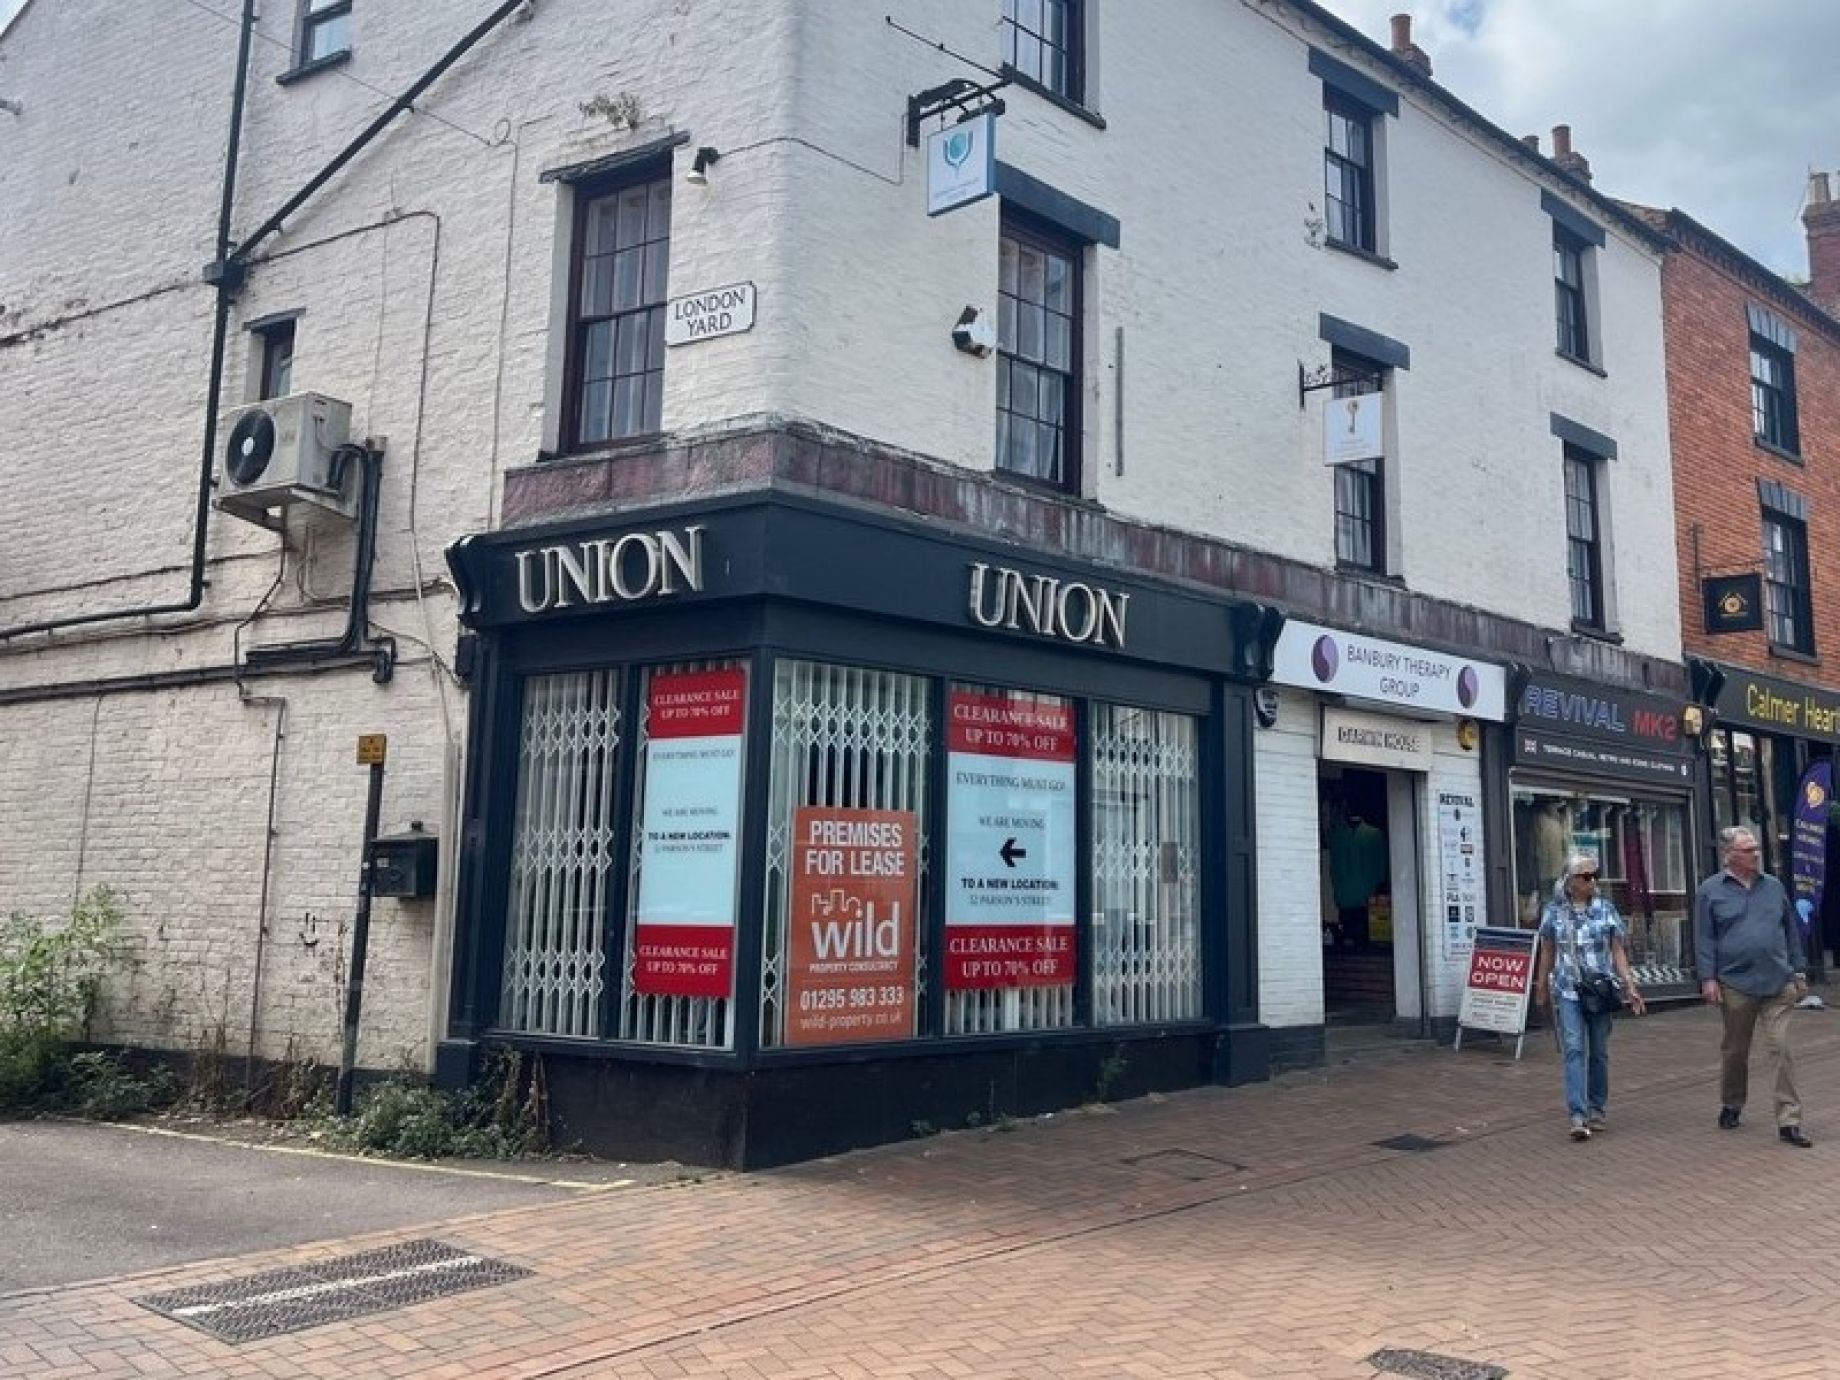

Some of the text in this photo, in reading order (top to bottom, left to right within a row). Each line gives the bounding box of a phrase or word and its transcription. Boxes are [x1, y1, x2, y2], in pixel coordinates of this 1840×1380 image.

[674, 286, 746, 321] LONDON
[688, 312, 732, 336] YARD
[515, 524, 707, 613] UNION
[969, 562, 1131, 648] UNION
[1347, 643, 1451, 681] BANBURY THERAPY
[655, 689, 738, 705] CLEARANCE SALE
[1380, 676, 1420, 697] GROUP
[711, 705, 730, 716] OFF
[1521, 685, 1678, 741] REVIVAL MK2
[1746, 682, 1801, 726] Calmer
[953, 703, 1068, 731] CLEARANCE SALE
[965, 728, 1058, 751] UP TO 70% OFF
[956, 772, 1020, 788] EVERYTHING
[1021, 776, 1047, 790] MUST
[978, 816, 992, 827] WE
[994, 817, 1010, 828] ARE
[647, 832, 659, 841] TO
[668, 832, 686, 840] NEW
[810, 820, 903, 847] PREMISES
[805, 849, 905, 876] FOR LEASE
[960, 878, 975, 889] TO
[977, 878, 985, 889] A
[986, 879, 1008, 889] NEW
[811, 901, 900, 959] wild
[641, 945, 729, 960] CLEARANCE SALE
[949, 936, 1068, 953] CLEARANCE SALE
[699, 963, 719, 976] OFF
[963, 959, 1059, 978] UP TO 70% OFF
[1477, 956, 1524, 972] NOW
[1471, 972, 1525, 988] OPEN
[800, 985, 905, 1011] 01295 983 333
